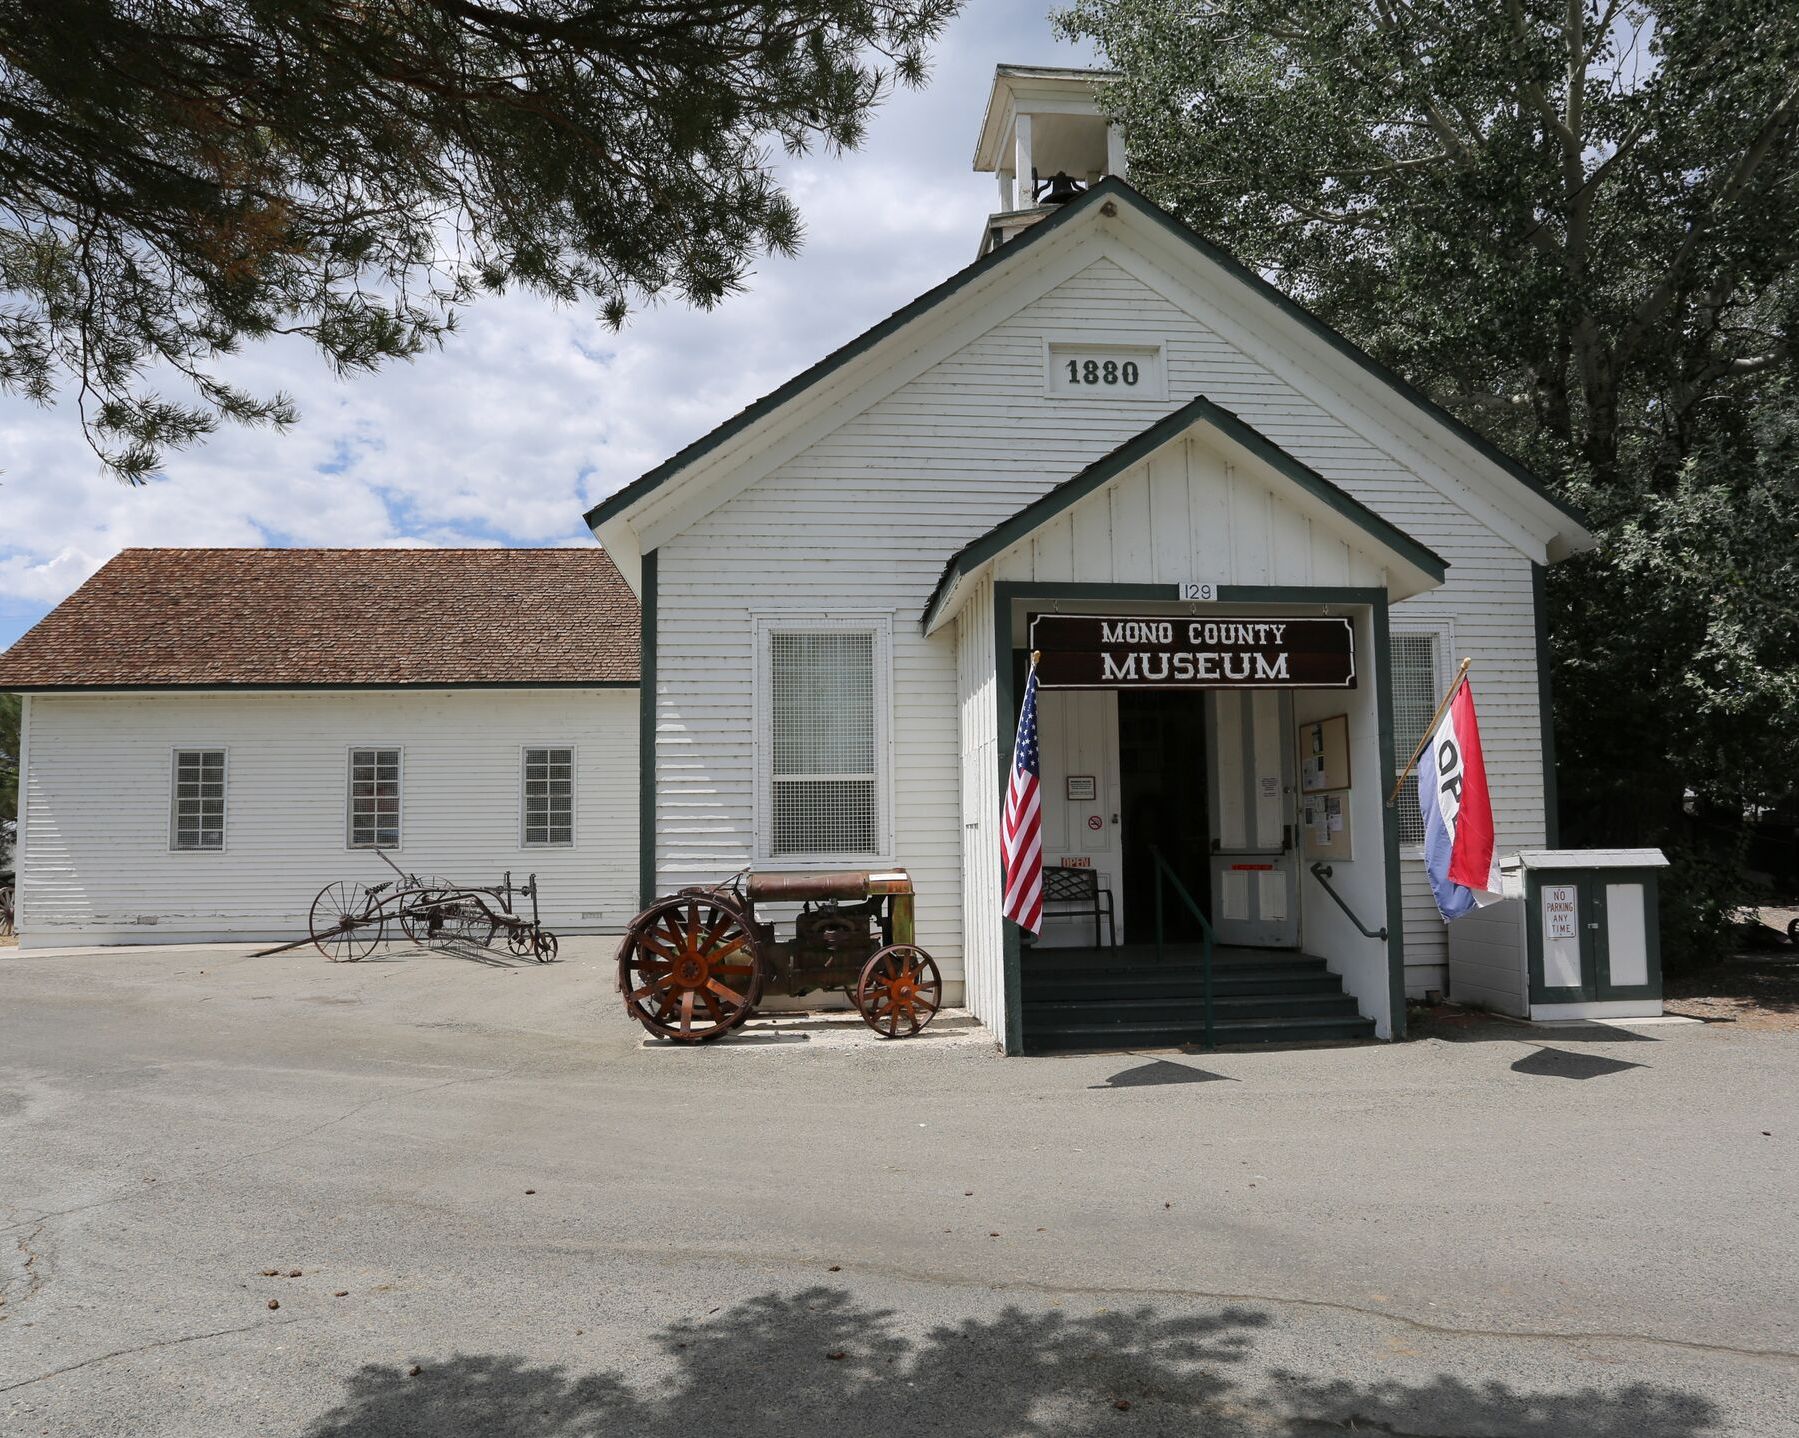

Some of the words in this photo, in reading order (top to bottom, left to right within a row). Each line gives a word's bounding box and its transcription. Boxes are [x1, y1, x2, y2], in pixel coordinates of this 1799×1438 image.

[1065, 359, 1139, 386] 1880
[1185, 584, 1211, 599] 129
[1101, 622, 1173, 643] MONO
[1189, 623, 1286, 644] COUNTY
[1101, 652, 1290, 679] MUSEUM
[1063, 857, 1089, 867] OPEN
[1553, 891, 1565, 901] NO
[1546, 903, 1573, 912] PARKING
[1553, 914, 1568, 922] ANY
[1552, 924, 1571, 933] TIME
